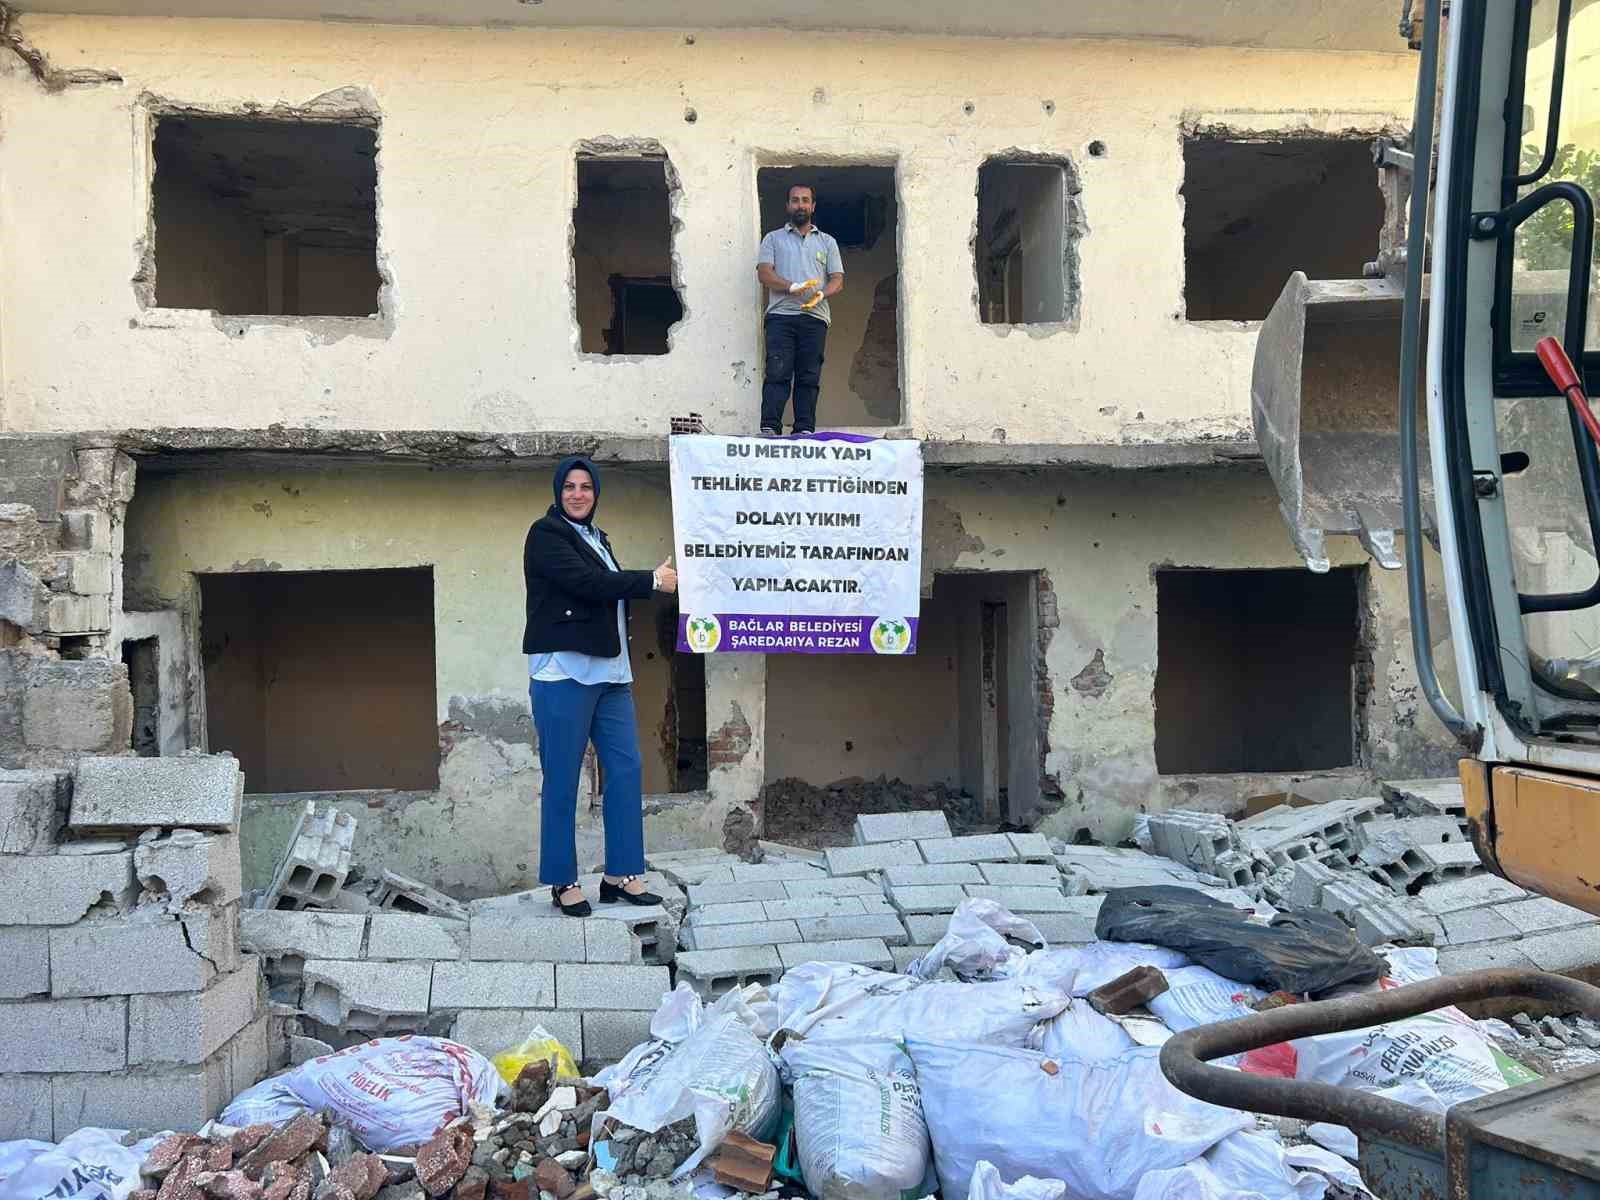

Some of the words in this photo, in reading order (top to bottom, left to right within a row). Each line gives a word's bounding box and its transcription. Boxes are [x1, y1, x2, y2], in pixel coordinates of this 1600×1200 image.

[726, 443, 750, 458] BU
[755, 444, 826, 460] METRUK
[831, 446, 872, 461] YAPI
[691, 474, 763, 492] TEHLİKE
[767, 478, 801, 492] ARZ
[806, 476, 908, 495] ETTİĞİNDEN
[736, 511, 801, 526] DOLAYI
[806, 512, 861, 527] YIKIMI
[684, 541, 796, 559] BELEDİYEMİZ
[800, 545, 909, 561] TARAFINDAN
[732, 577, 862, 593] YAPILACAKTIR.
[729, 618, 784, 632] BAĞLAR
[789, 619, 862, 633] BELEDİYESİ
[731, 635, 815, 648] ŞAREDARIYA
[818, 636, 860, 648] REZAN
